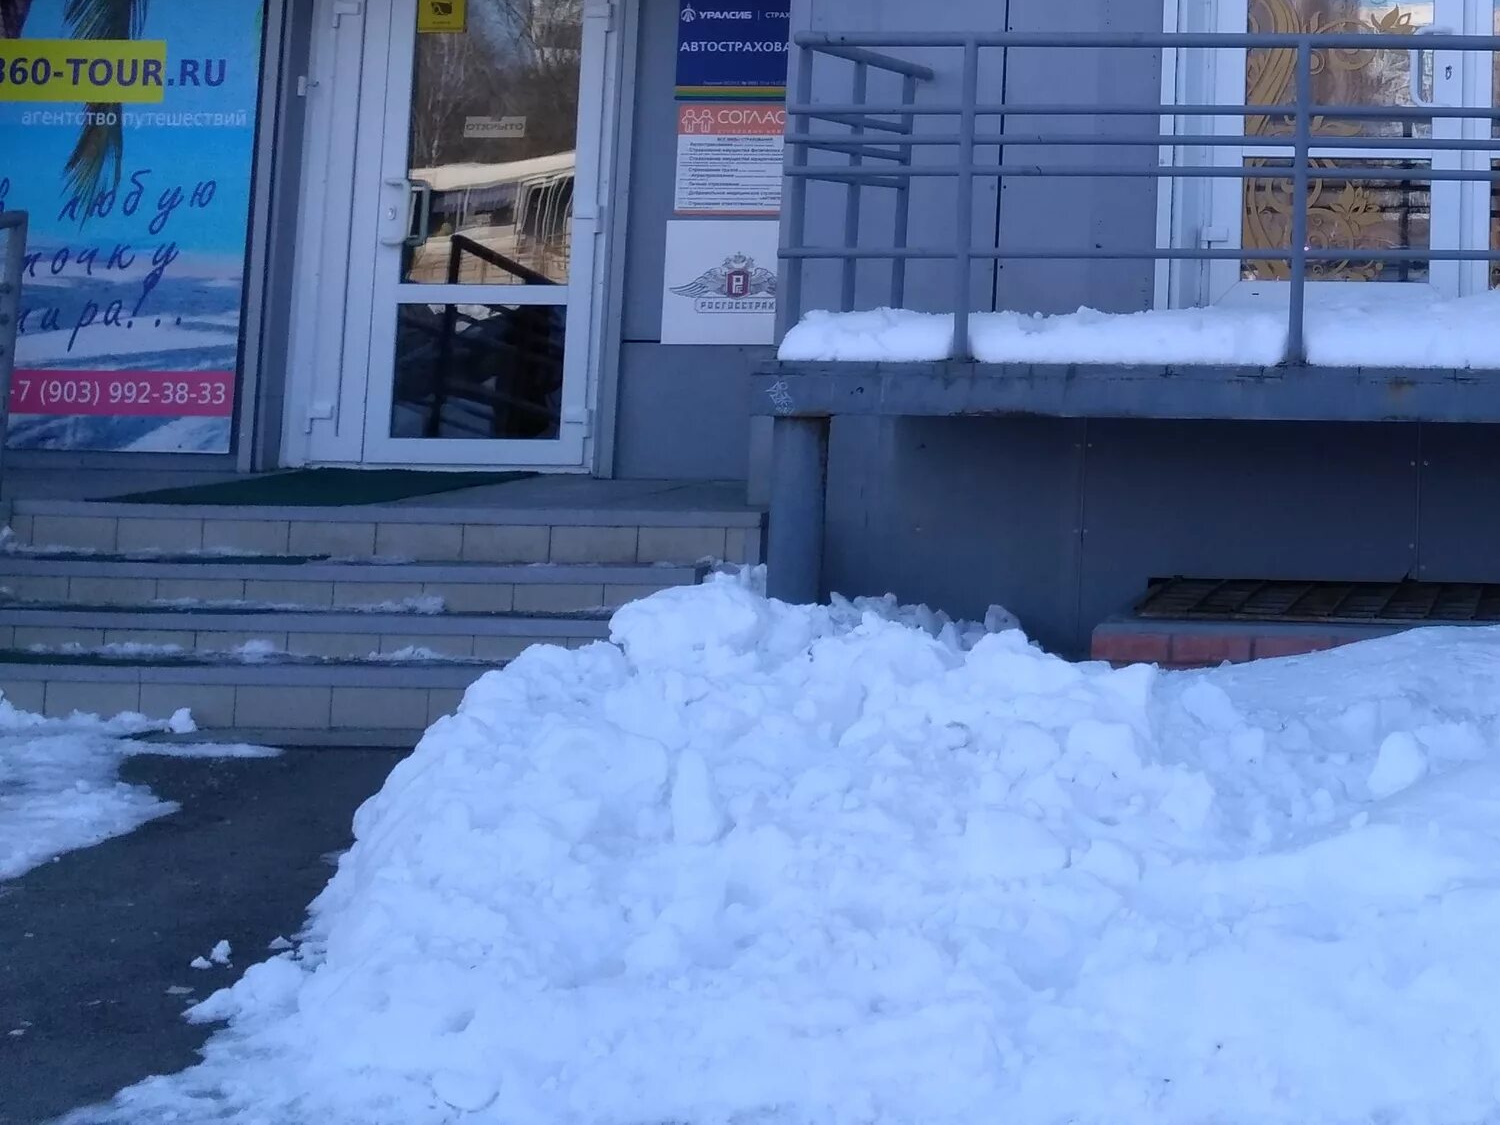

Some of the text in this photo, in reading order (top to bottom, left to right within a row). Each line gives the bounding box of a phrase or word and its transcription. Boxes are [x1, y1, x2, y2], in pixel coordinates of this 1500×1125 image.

[700, 11, 752, 20] УРАЛСИБ
[21, 109, 247, 129] агентство путешествий
[58, 169, 217, 235] любую
[700, 301, 775, 310] РОСГОССТРАХ
[40, 380, 100, 406] (903)
[109, 381, 226, 405] 992-38-33
